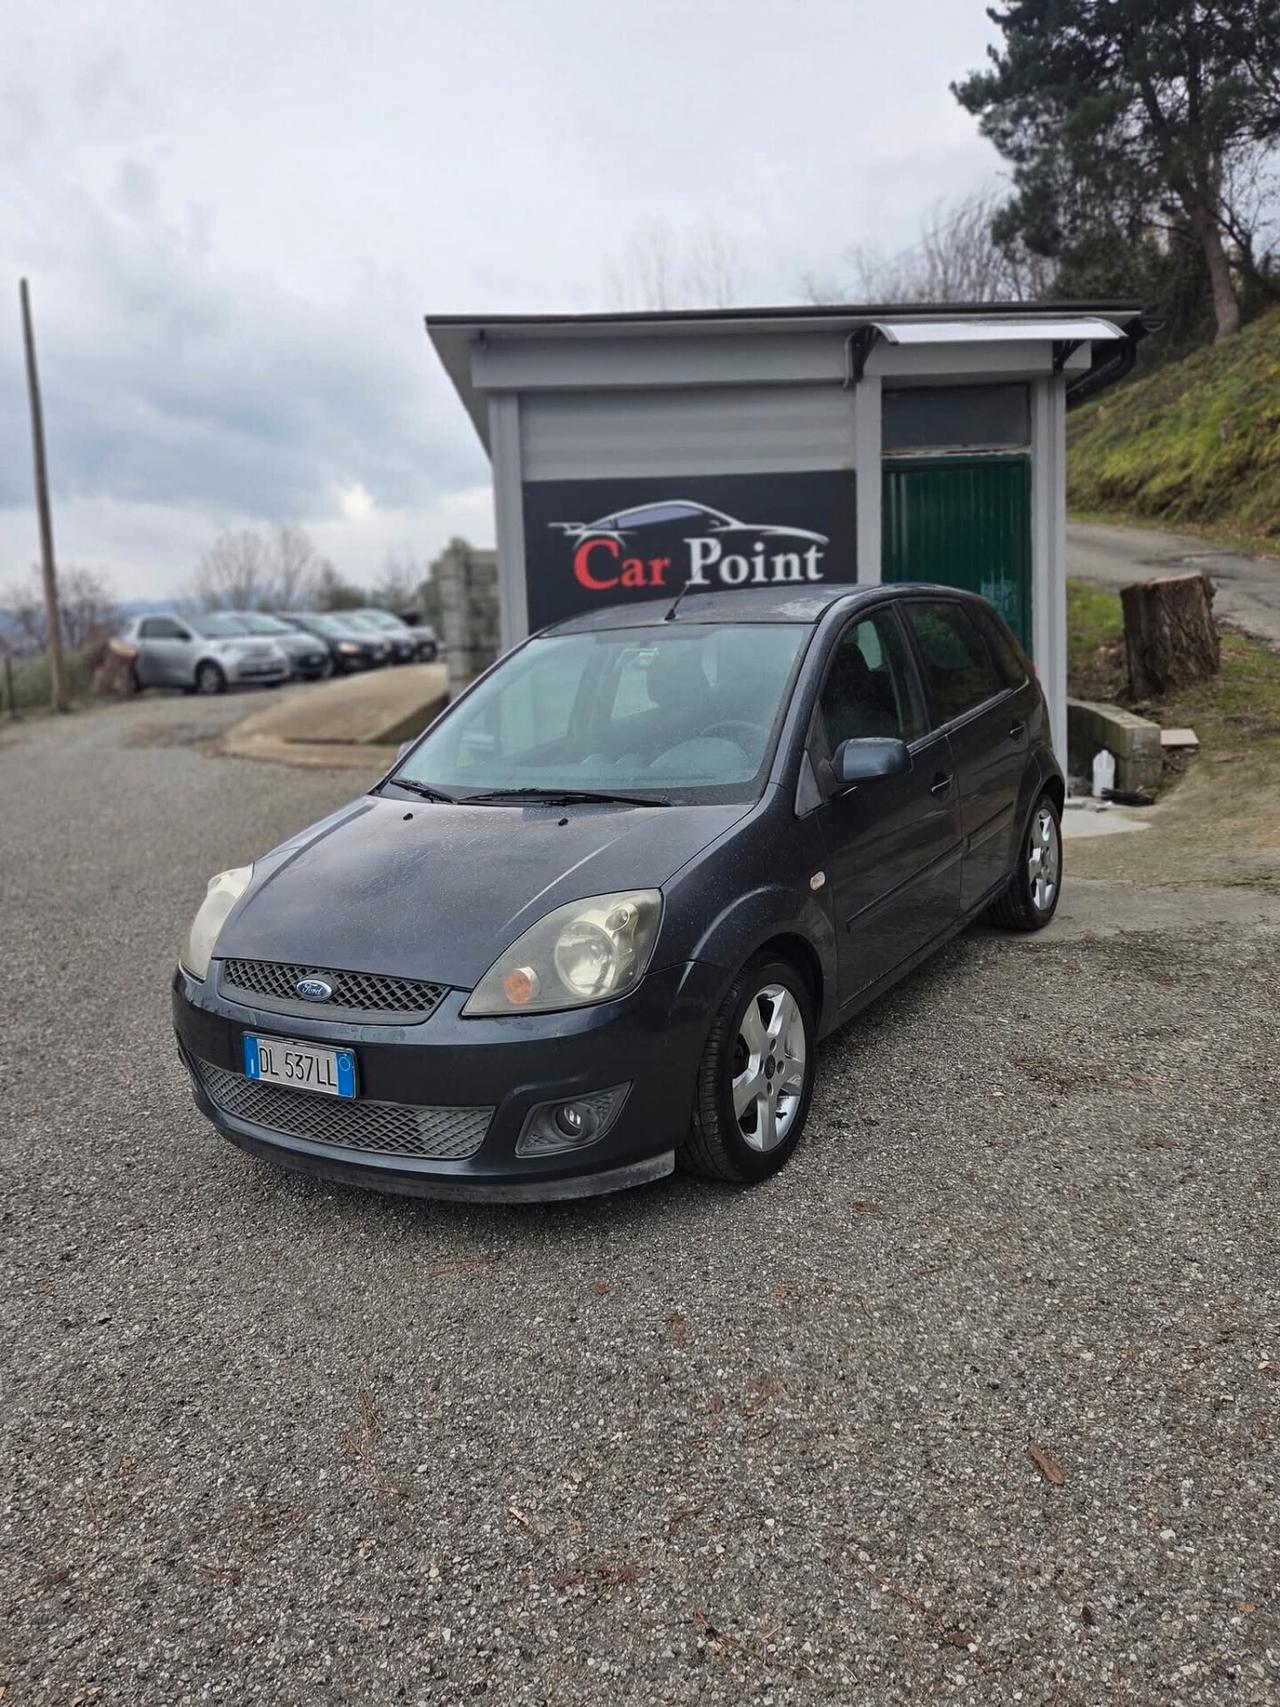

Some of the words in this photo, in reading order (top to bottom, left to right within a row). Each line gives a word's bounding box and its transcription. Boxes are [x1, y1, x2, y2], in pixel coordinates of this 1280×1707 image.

[573, 538, 671, 590] Car
[683, 537, 825, 585] Point
[302, 982, 324, 994] Ford
[259, 1047, 279, 1076] DL
[284, 1052, 337, 1087] 537LL
